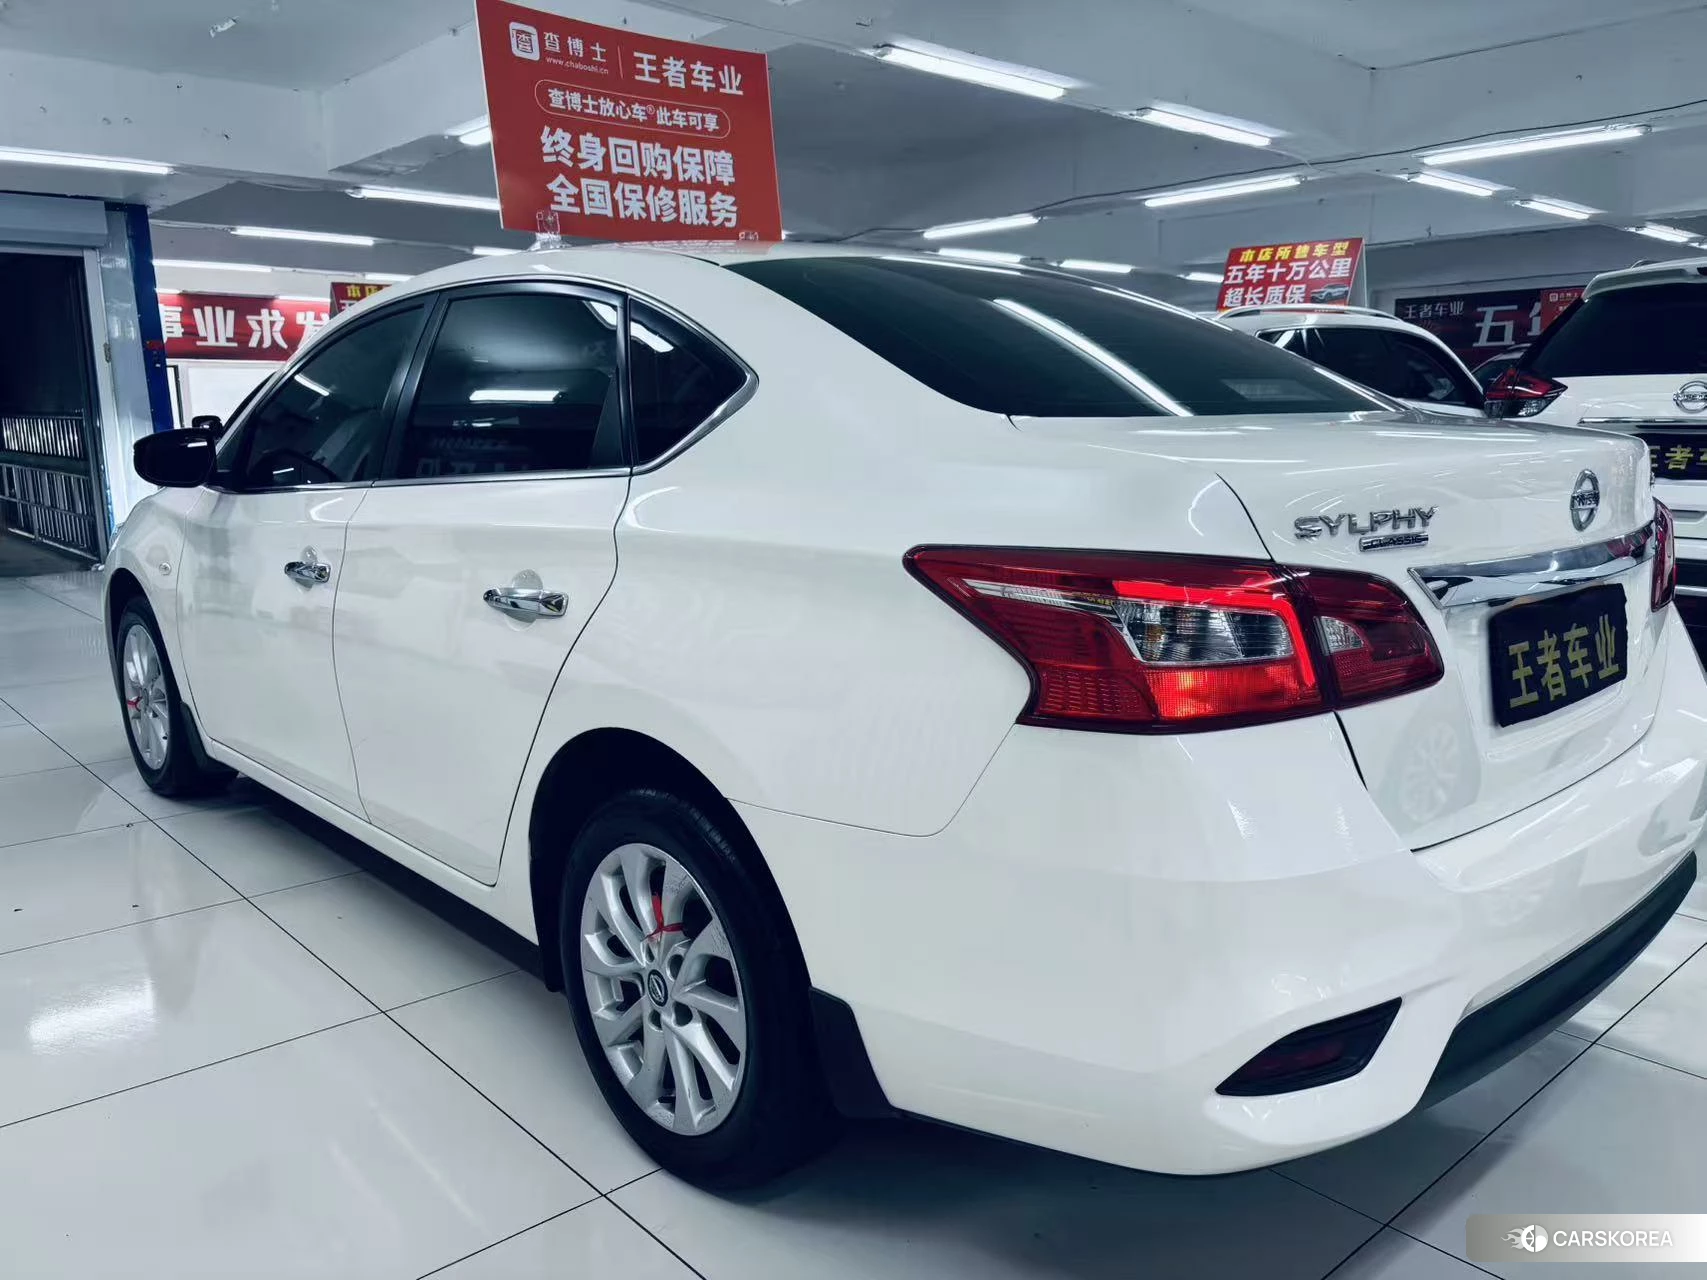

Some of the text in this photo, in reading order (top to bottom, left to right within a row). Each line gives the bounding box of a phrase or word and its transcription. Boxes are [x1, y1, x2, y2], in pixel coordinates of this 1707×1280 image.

[543, 31, 607, 62] 查博士
[545, 56, 609, 75] www.chaboshi.cn
[633, 51, 744, 96] 王者车业
[540, 125, 736, 187] 终身回购保障
[547, 173, 739, 228] 全国保修服务
[1240, 241, 1350, 262] 本店所售车型
[1224, 257, 1353, 284] 五年十万公里
[1223, 284, 1307, 307] 超长质保
[1404, 299, 1464, 319] 王者车业
[1294, 505, 1439, 539] SYLPHY
[1508, 614, 1619, 708] 王者车业
